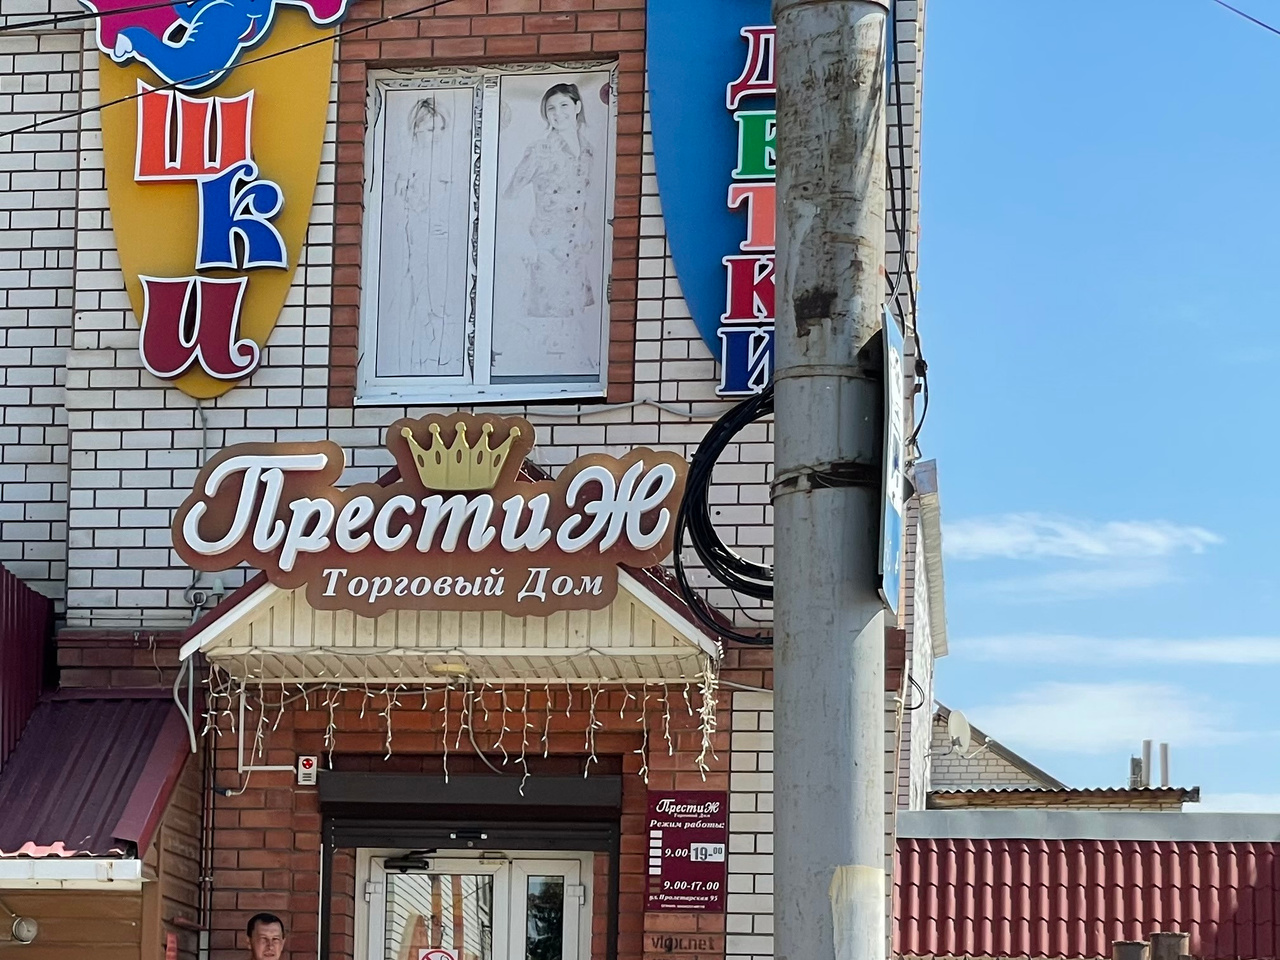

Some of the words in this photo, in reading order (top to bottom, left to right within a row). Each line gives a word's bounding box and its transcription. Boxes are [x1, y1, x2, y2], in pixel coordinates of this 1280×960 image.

[322, 567, 504, 603] Торговый
[518, 567, 603, 602] Дом
[650, 820, 682, 828] Режим
[684, 820, 725, 829] работы:
[663, 881, 720, 890] 9.00-17.00
